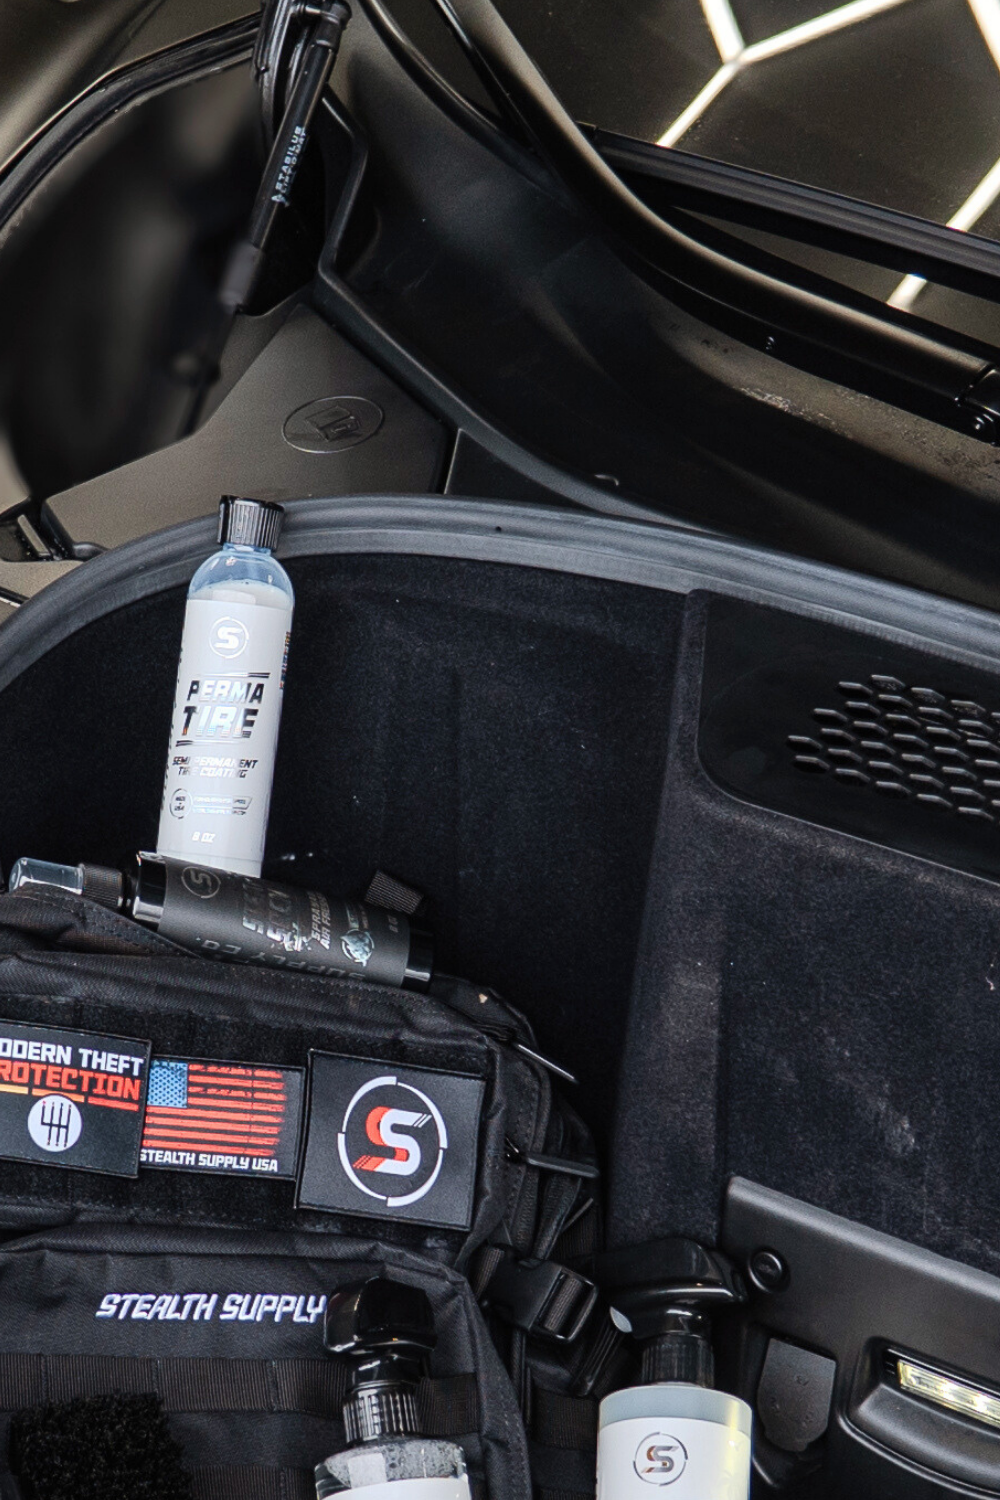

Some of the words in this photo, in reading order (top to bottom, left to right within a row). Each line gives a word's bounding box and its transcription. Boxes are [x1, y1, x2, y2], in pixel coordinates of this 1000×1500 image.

[186, 680, 265, 704] PERMA
[181, 705, 259, 739] TIRE
[78, 1048, 144, 1077] THEFT
[139, 1148, 197, 1166] STEALTH
[198, 1153, 250, 1170] SUPPLY
[252, 1157, 278, 1173] USA
[95, 1292, 219, 1321] STEALTH
[219, 1292, 328, 1324] SUPPLY
